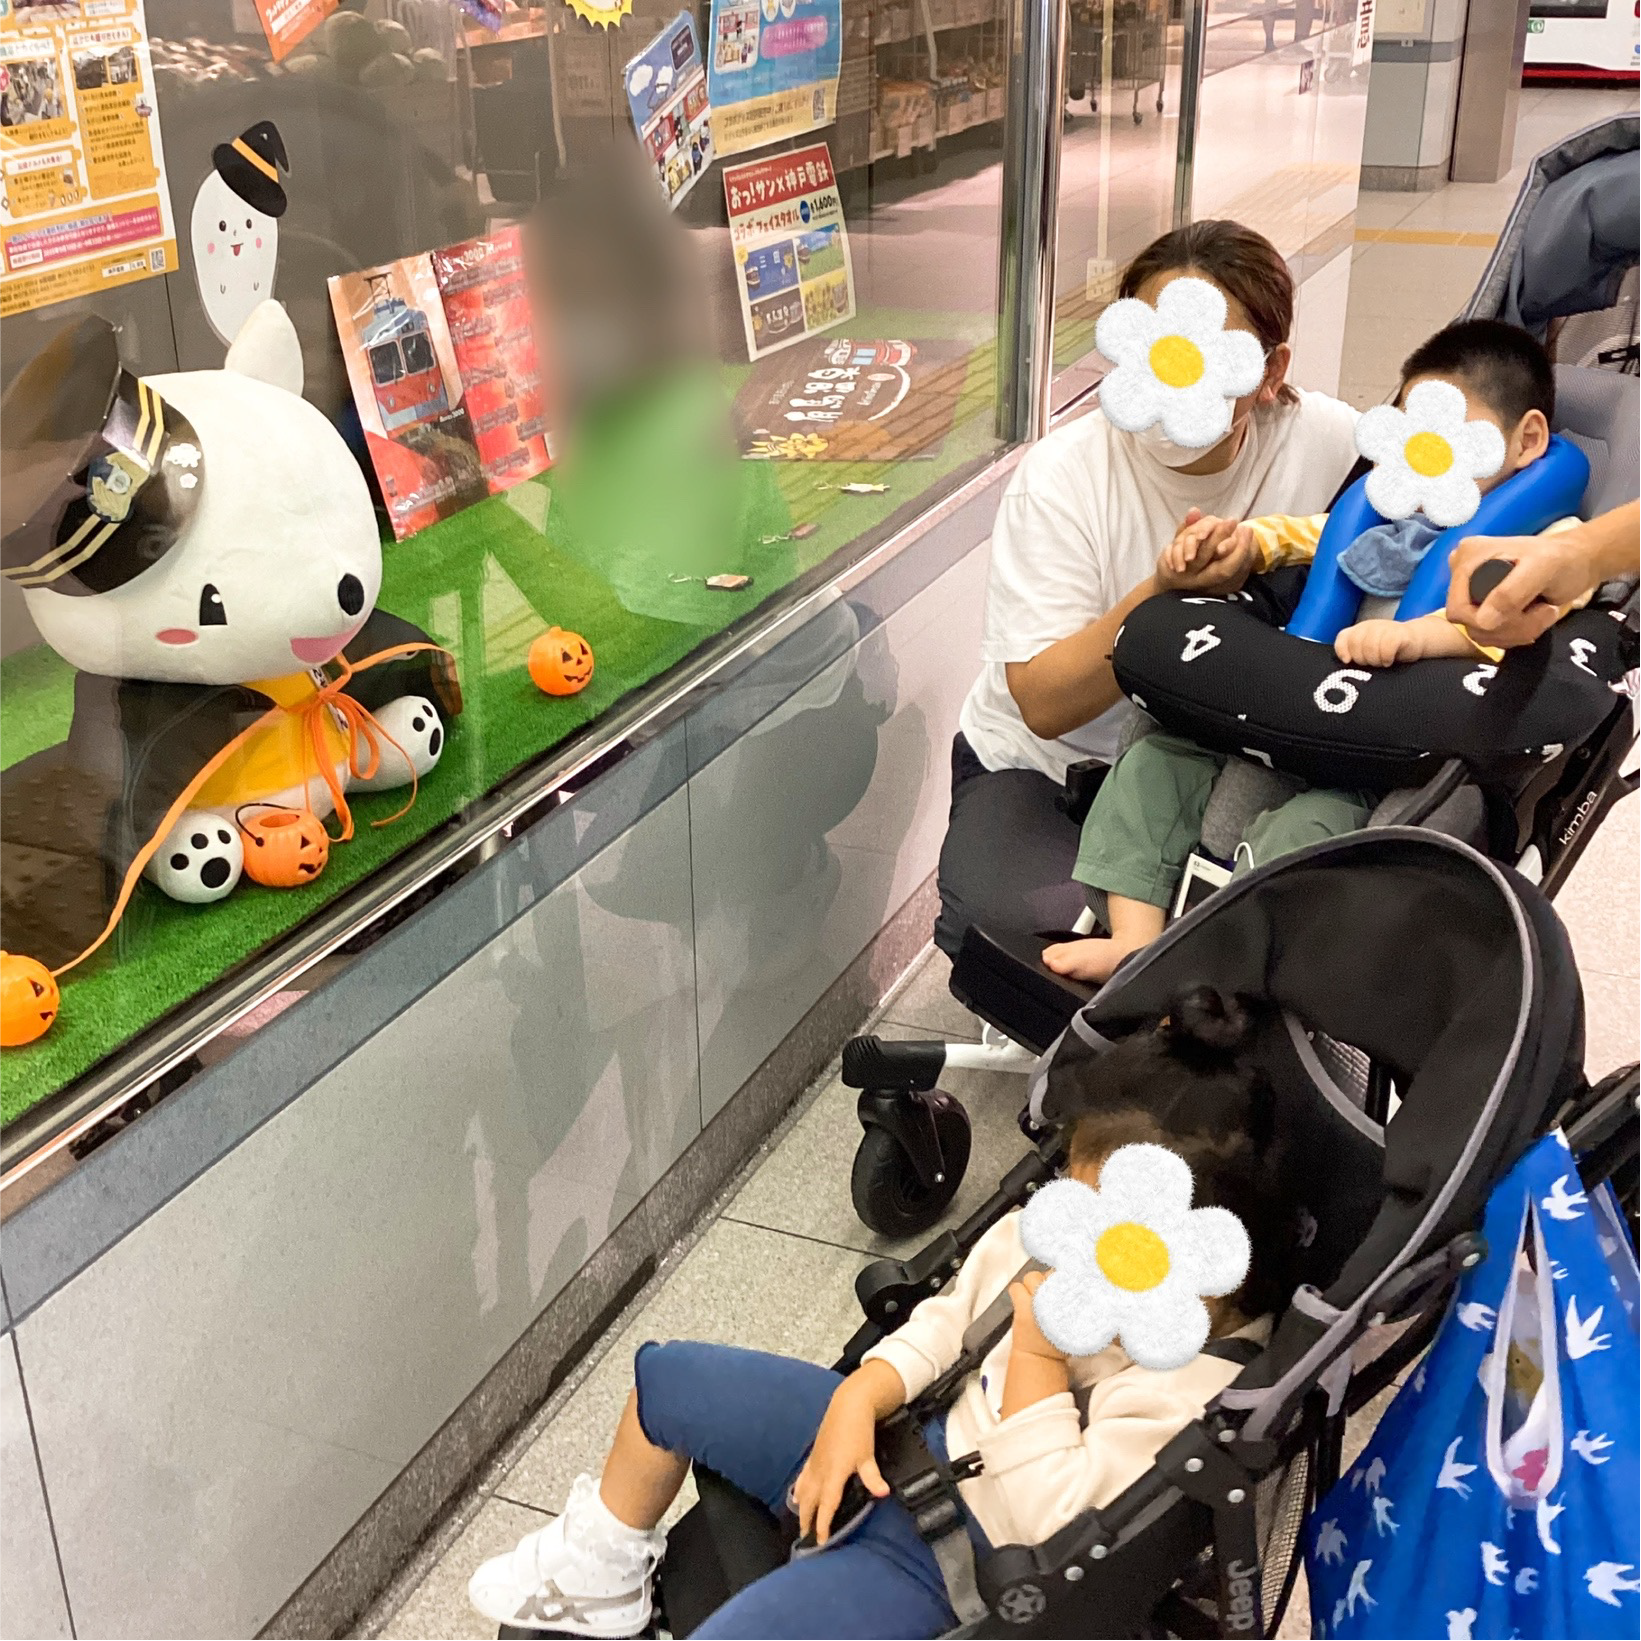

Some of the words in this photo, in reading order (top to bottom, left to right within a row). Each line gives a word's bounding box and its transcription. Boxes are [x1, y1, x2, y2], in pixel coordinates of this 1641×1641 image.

[1181, 624, 1221, 662] 4
[1558, 790, 1598, 845] kimba
[1226, 1558, 1257, 1631] Jeep
